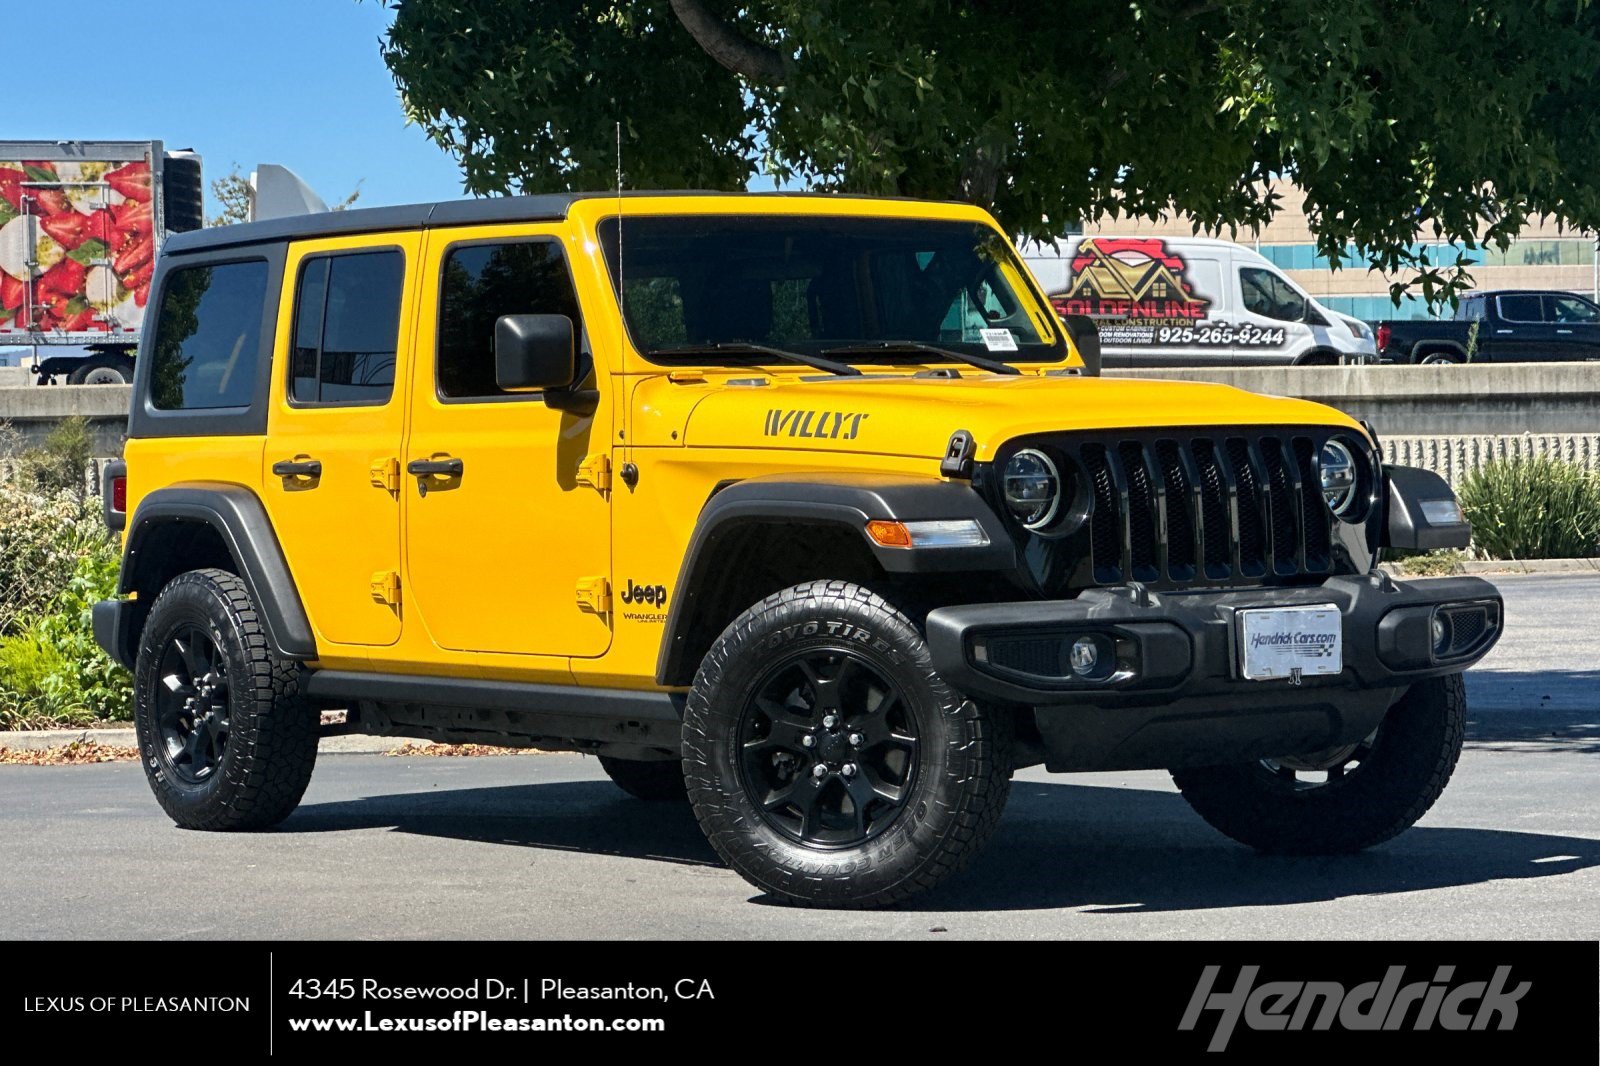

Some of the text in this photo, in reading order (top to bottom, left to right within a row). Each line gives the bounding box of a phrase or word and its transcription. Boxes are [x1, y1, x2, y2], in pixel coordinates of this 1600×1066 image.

[1115, 318, 1194, 327] CONSTRUCTION
[1114, 331, 1154, 339] RENOVATIONS
[1159, 326, 1284, 345] 925-265-9244
[764, 409, 869, 440] WILLYS
[621, 579, 667, 609] Jeep
[623, 612, 668, 620] WRANGLER
